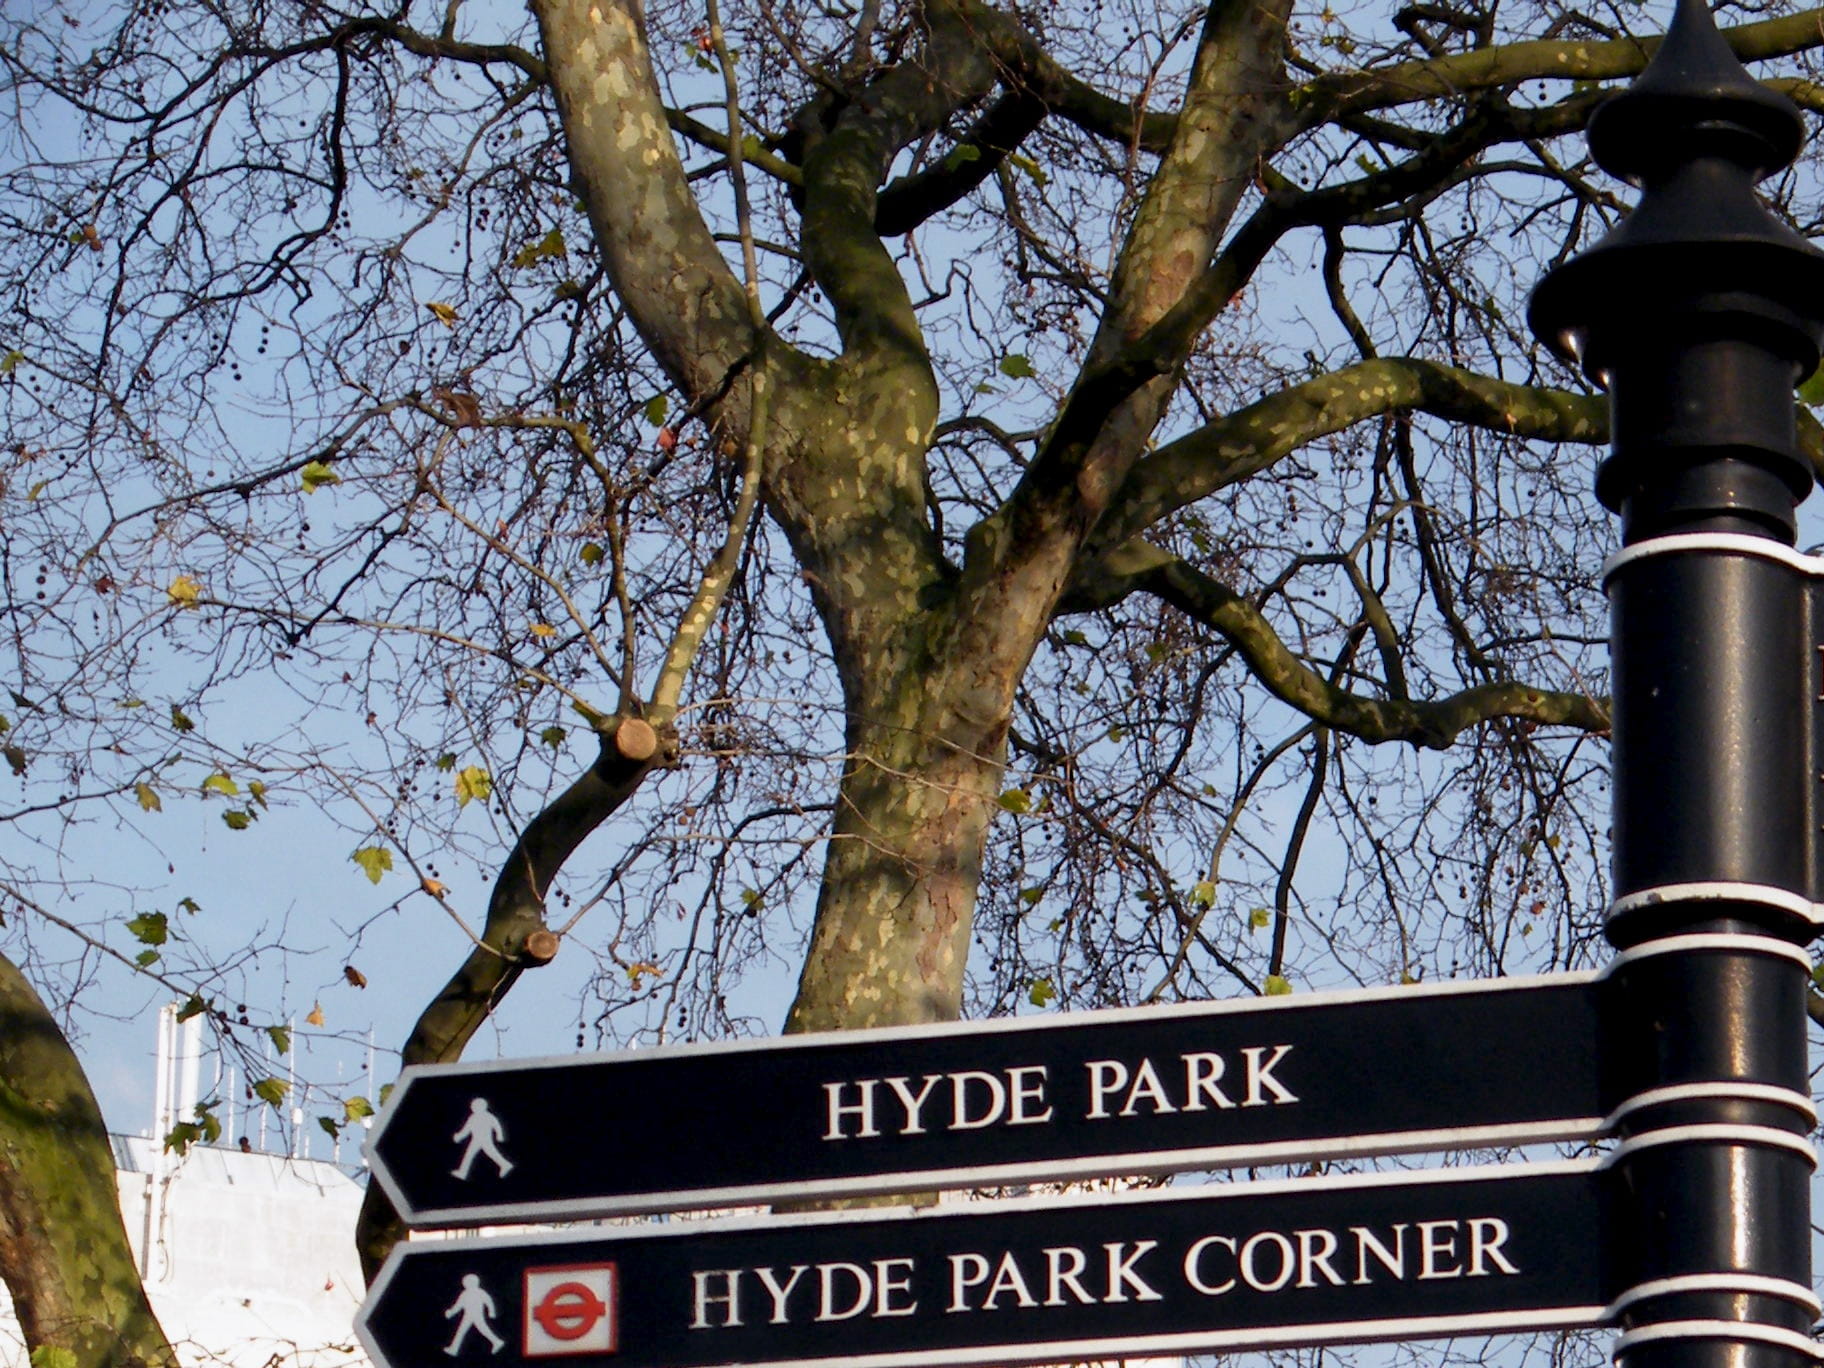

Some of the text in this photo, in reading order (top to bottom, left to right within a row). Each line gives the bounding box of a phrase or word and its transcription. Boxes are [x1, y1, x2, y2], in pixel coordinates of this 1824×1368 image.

[823, 1045, 1299, 1139] HYDE PARK
[689, 1218, 1519, 1330] HYDE PARK CORNER
